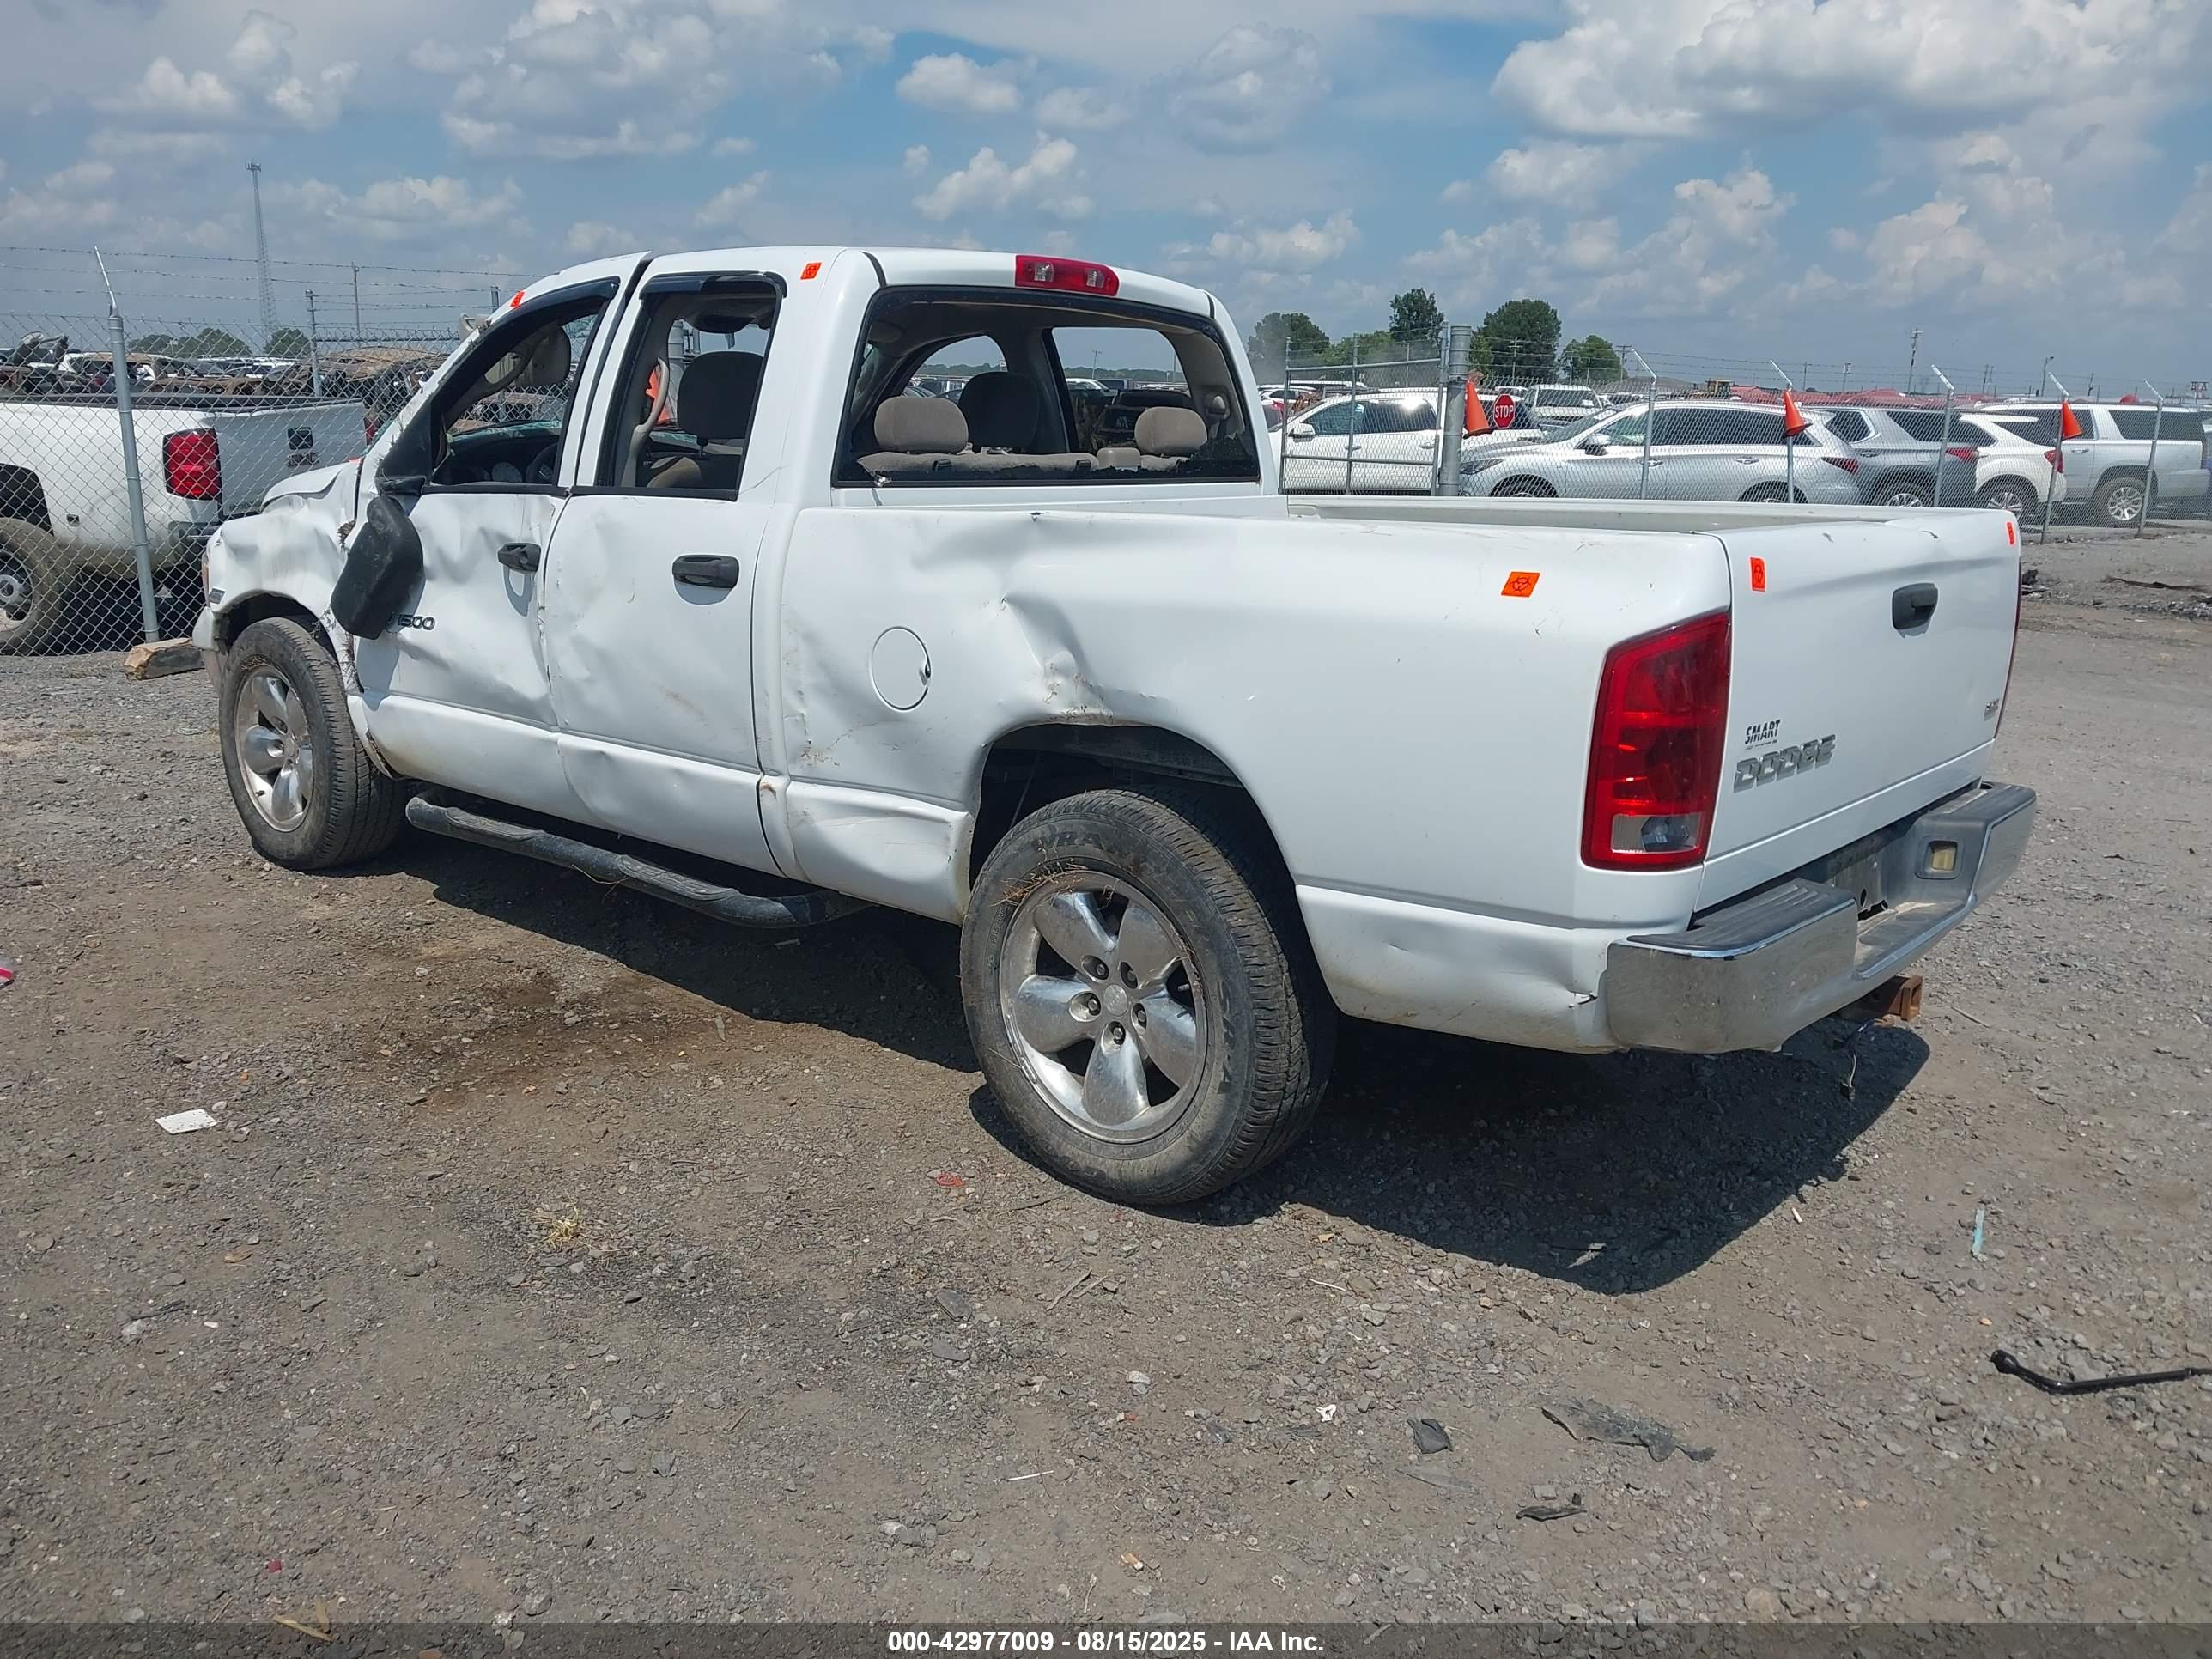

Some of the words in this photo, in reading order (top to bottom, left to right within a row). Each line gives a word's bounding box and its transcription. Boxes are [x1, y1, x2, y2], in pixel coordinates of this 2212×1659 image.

[1495, 404, 1514, 419] STOP
[398, 614, 436, 631] 1500
[1745, 719, 1781, 745] SMART
[1733, 734, 1837, 794] DODGE
